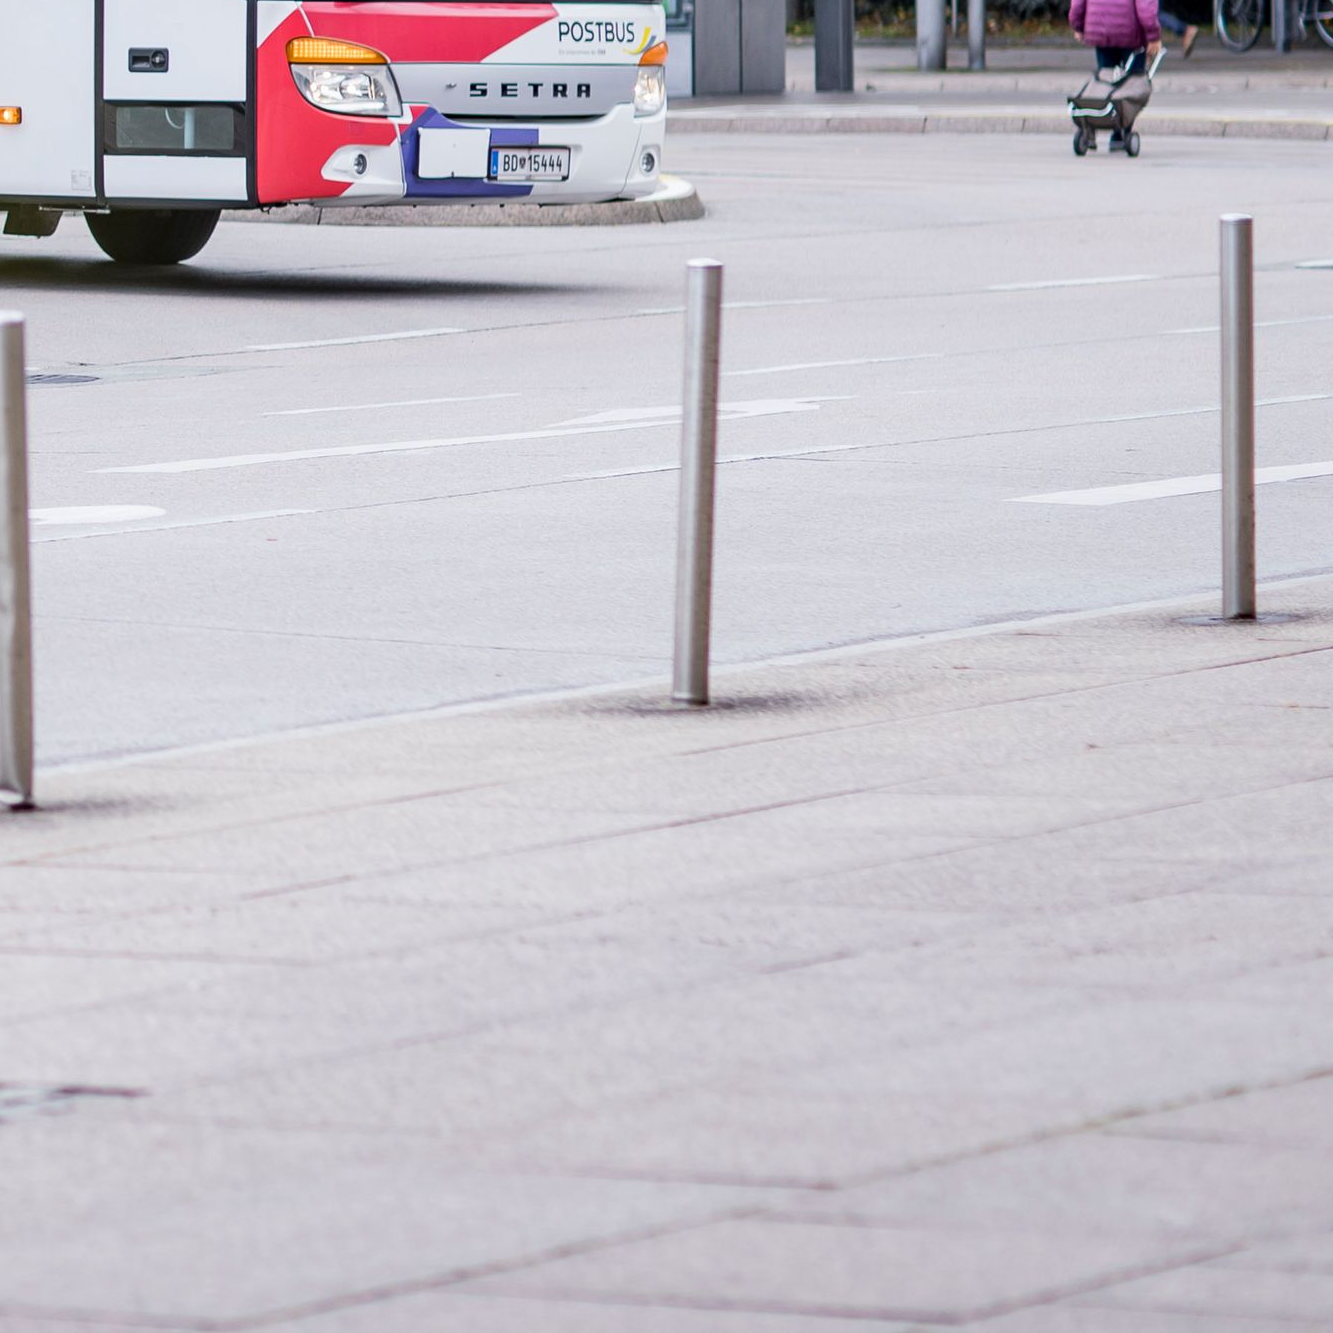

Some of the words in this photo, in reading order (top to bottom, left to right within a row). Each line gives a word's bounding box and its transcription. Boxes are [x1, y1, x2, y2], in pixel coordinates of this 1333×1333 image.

[558, 21, 635, 43] POSTBUS
[469, 82, 592, 99] SETRA
[503, 153, 518, 172] BD
[527, 153, 562, 173] 15444
